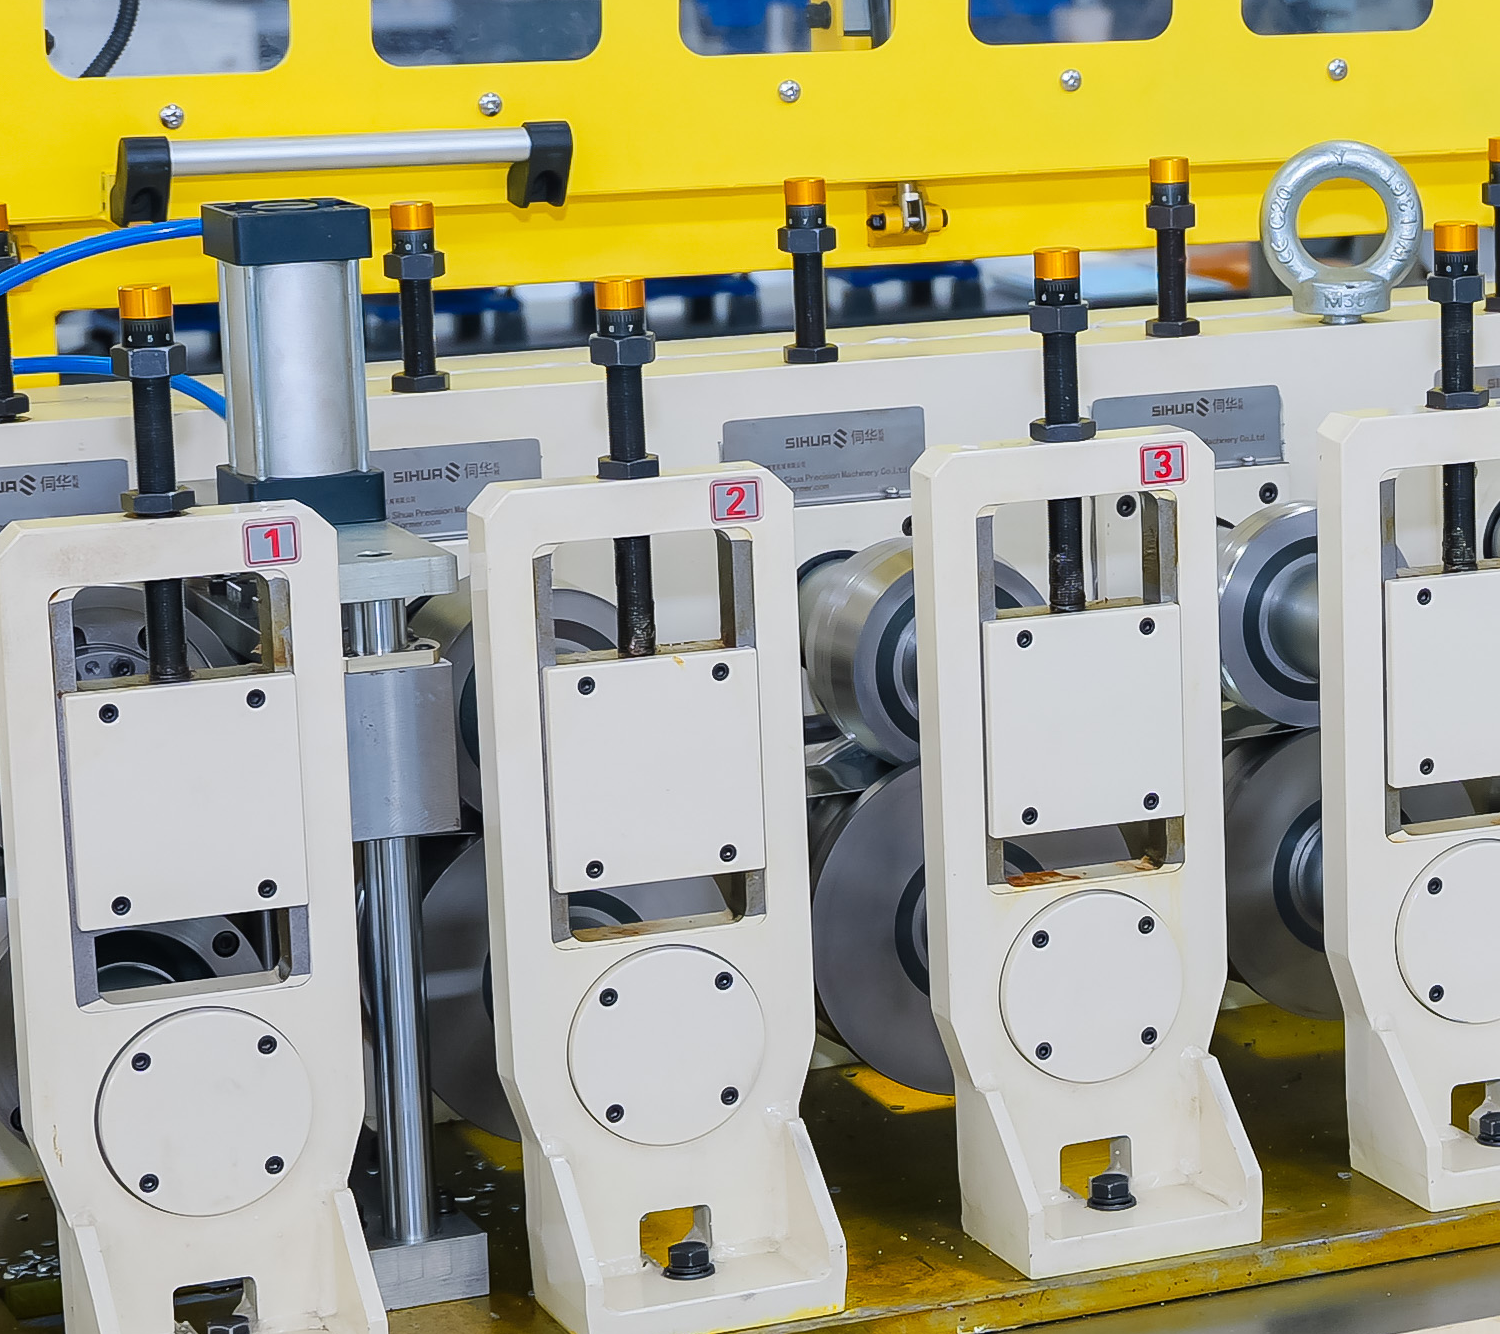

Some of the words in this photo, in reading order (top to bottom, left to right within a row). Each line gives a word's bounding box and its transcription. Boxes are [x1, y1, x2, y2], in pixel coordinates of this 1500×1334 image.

[1269, 186, 1293, 230] C20
[1324, 292, 1366, 309] M30
[1151, 403, 1195, 417] SIHUA
[1212, 397, 1238, 413] 伺华
[785, 434, 831, 449] SIHUA
[851, 428, 878, 445] 伺华
[393, 468, 443, 484] SIHUA
[464, 461, 493, 479] 伺华
[1153, 450, 1173, 479] 3
[40, 474, 72, 492] 伺华
[726, 487, 746, 516] 2
[264, 528, 280, 558] 1
